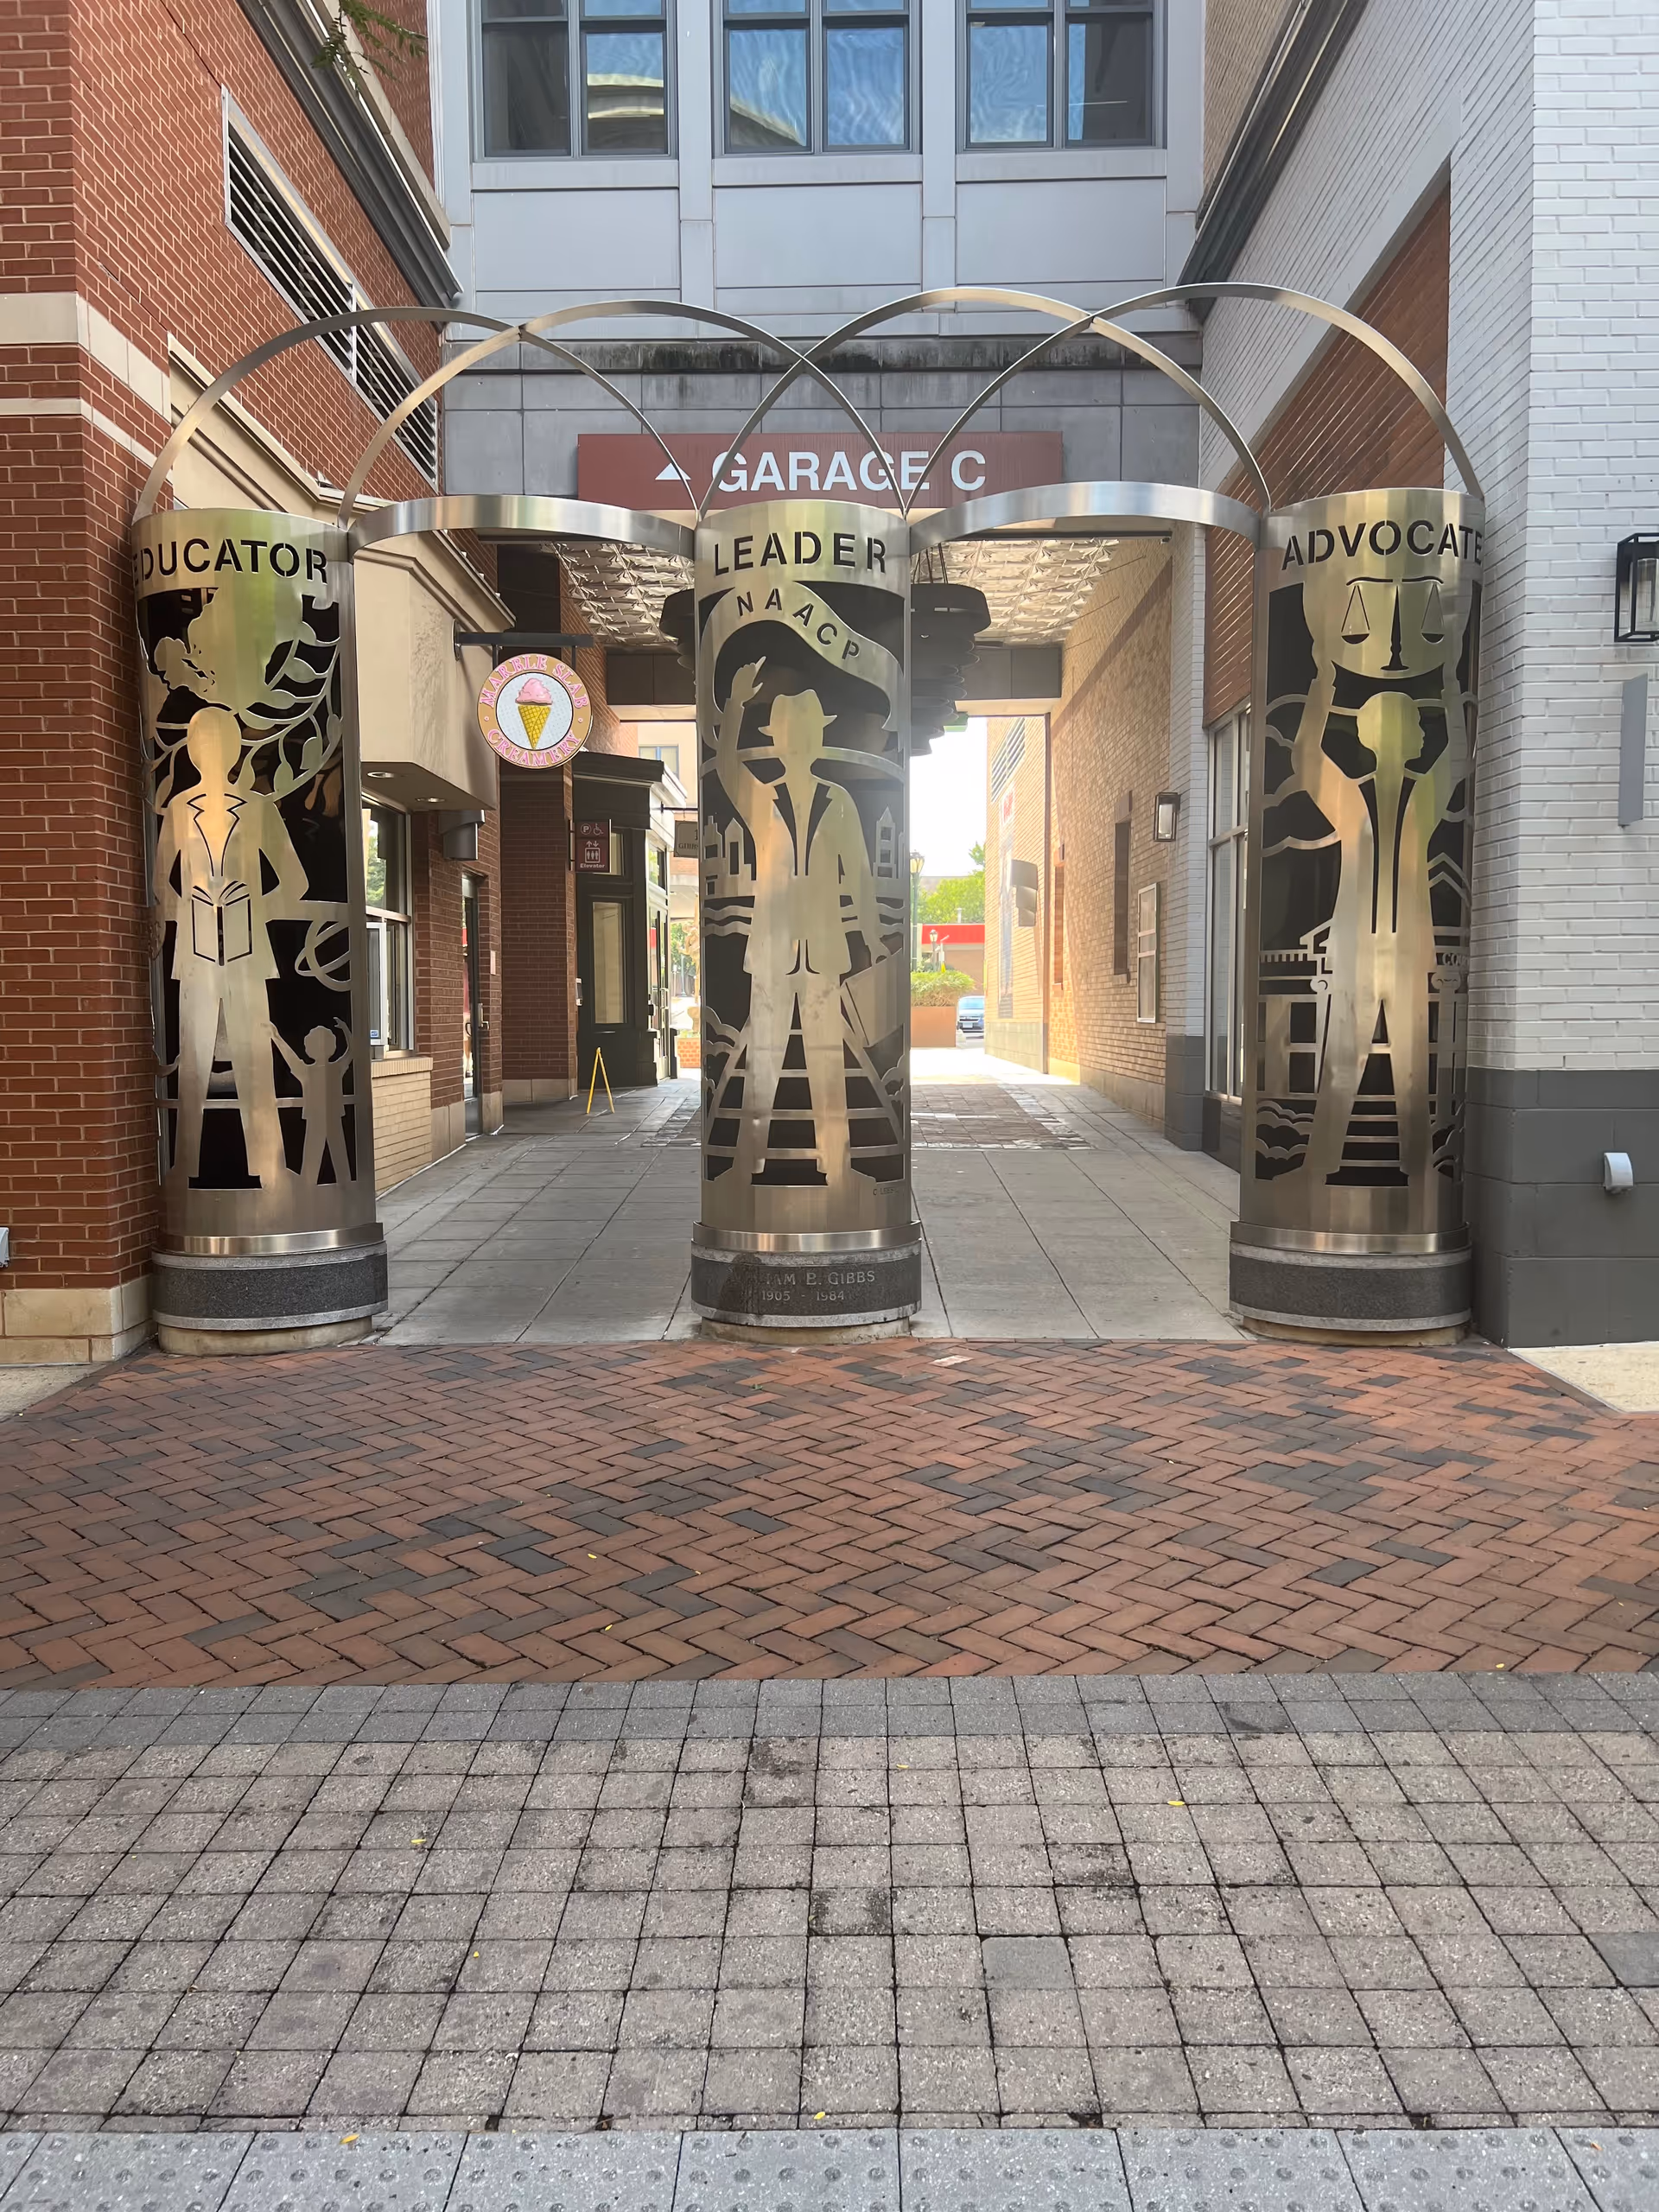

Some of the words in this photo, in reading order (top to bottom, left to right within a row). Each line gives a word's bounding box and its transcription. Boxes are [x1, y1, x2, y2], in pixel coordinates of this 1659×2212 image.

[712, 450, 929, 493] GARAGE
[950, 450, 987, 491] C
[715, 531, 887, 576] LEADER
[1281, 519, 1482, 571] ADVOCATE
[736, 588, 860, 660] NAACP
[480, 655, 548, 709] MARBLE
[552, 662, 588, 709] SLAB
[487, 728, 582, 767] CREAMERY
[762, 1291, 791, 1301] 1905
[817, 1290, 844, 1301] 1984
[828, 1270, 875, 1286] GIBBS
